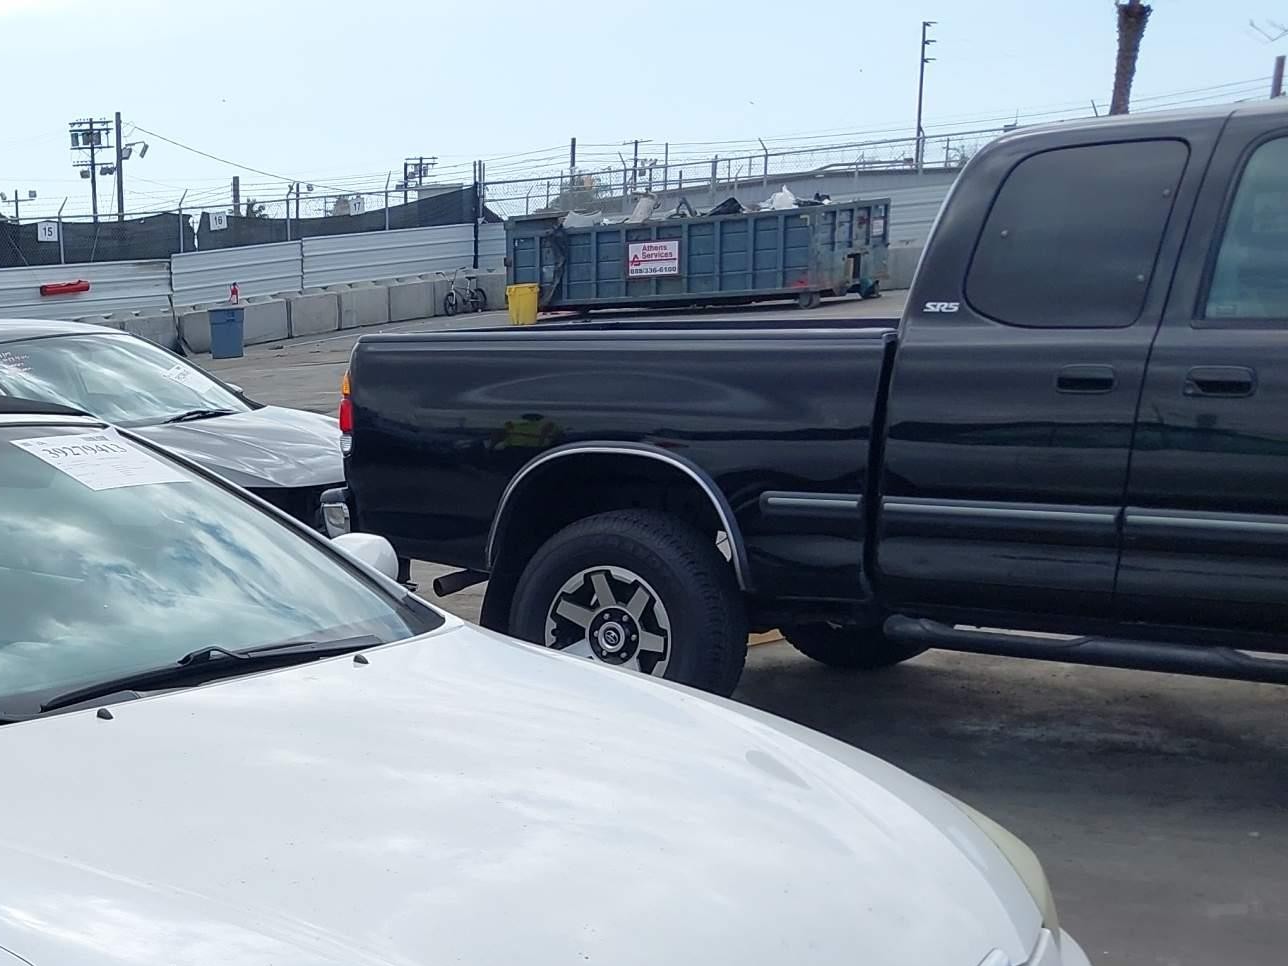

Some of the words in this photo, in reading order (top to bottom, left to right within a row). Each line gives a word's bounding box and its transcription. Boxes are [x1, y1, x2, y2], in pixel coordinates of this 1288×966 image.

[353, 201, 361, 211] 17
[214, 215, 223, 226] 16
[42, 226, 53, 237] 15
[641, 243, 668, 251] Athens
[641, 251, 673, 260] Services
[922, 301, 961, 313] SR5
[42, 442, 128, 459] 39279413
